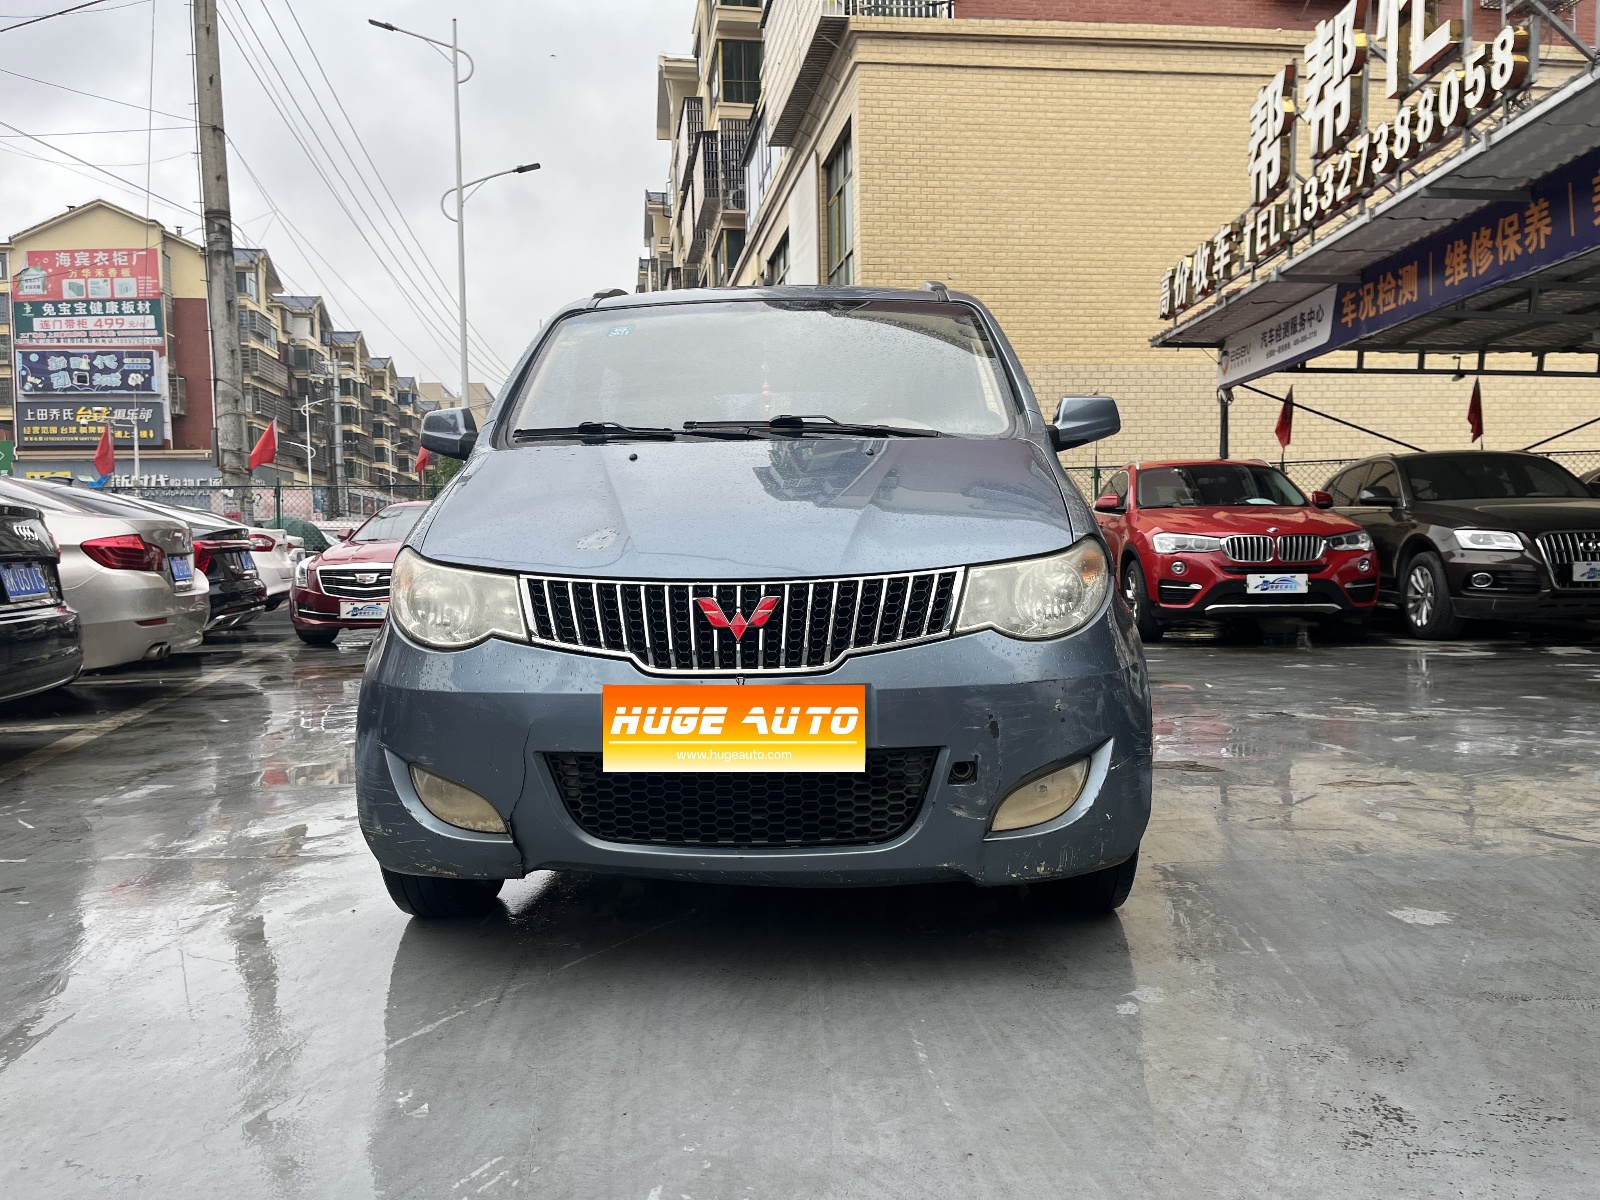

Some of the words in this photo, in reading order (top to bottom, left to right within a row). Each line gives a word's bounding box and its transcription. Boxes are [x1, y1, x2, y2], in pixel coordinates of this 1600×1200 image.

[1160, 225, 1232, 316] 高价收车
[1244, 25, 1515, 262] TEL:13327388058
[55, 251, 147, 267] 海宾衣柜厂
[1340, 260, 1418, 328] 车况检测
[1444, 197, 1552, 287] 维修保养
[40, 318, 89, 329] 连门带柜
[94, 318, 125, 329] 499
[42, 301, 152, 316] 兔宝宝健康板材
[1261, 304, 1325, 350] 汽车检测服务中心
